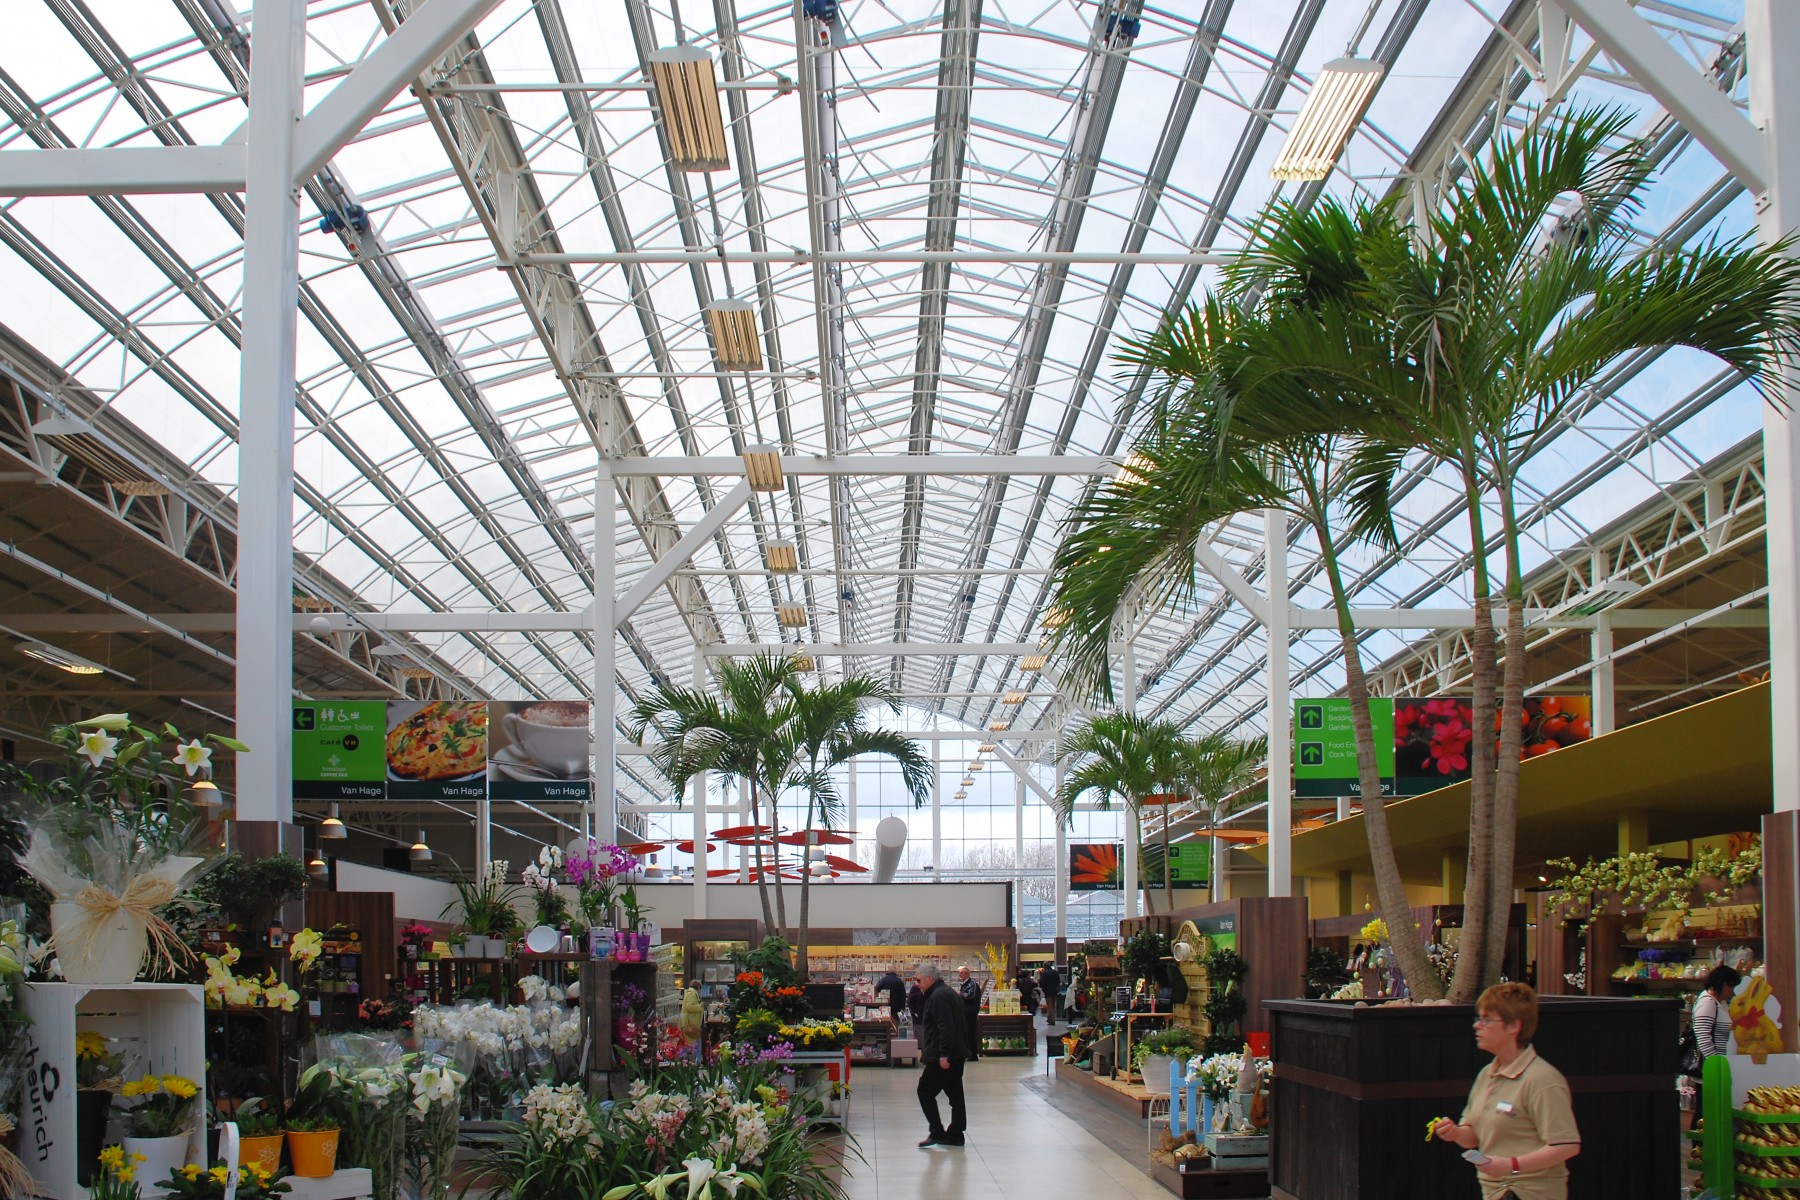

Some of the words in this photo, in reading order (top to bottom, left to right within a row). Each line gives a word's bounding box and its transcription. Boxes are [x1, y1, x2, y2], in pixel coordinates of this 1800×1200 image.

[341, 786, 357, 795] Van
[359, 786, 382, 797] Hage
[442, 787, 459, 796] Van
[460, 787, 483, 797] Hage
[544, 787, 561, 796] Van
[563, 787, 586, 797] Hage
[1350, 783, 1361, 791] Va
